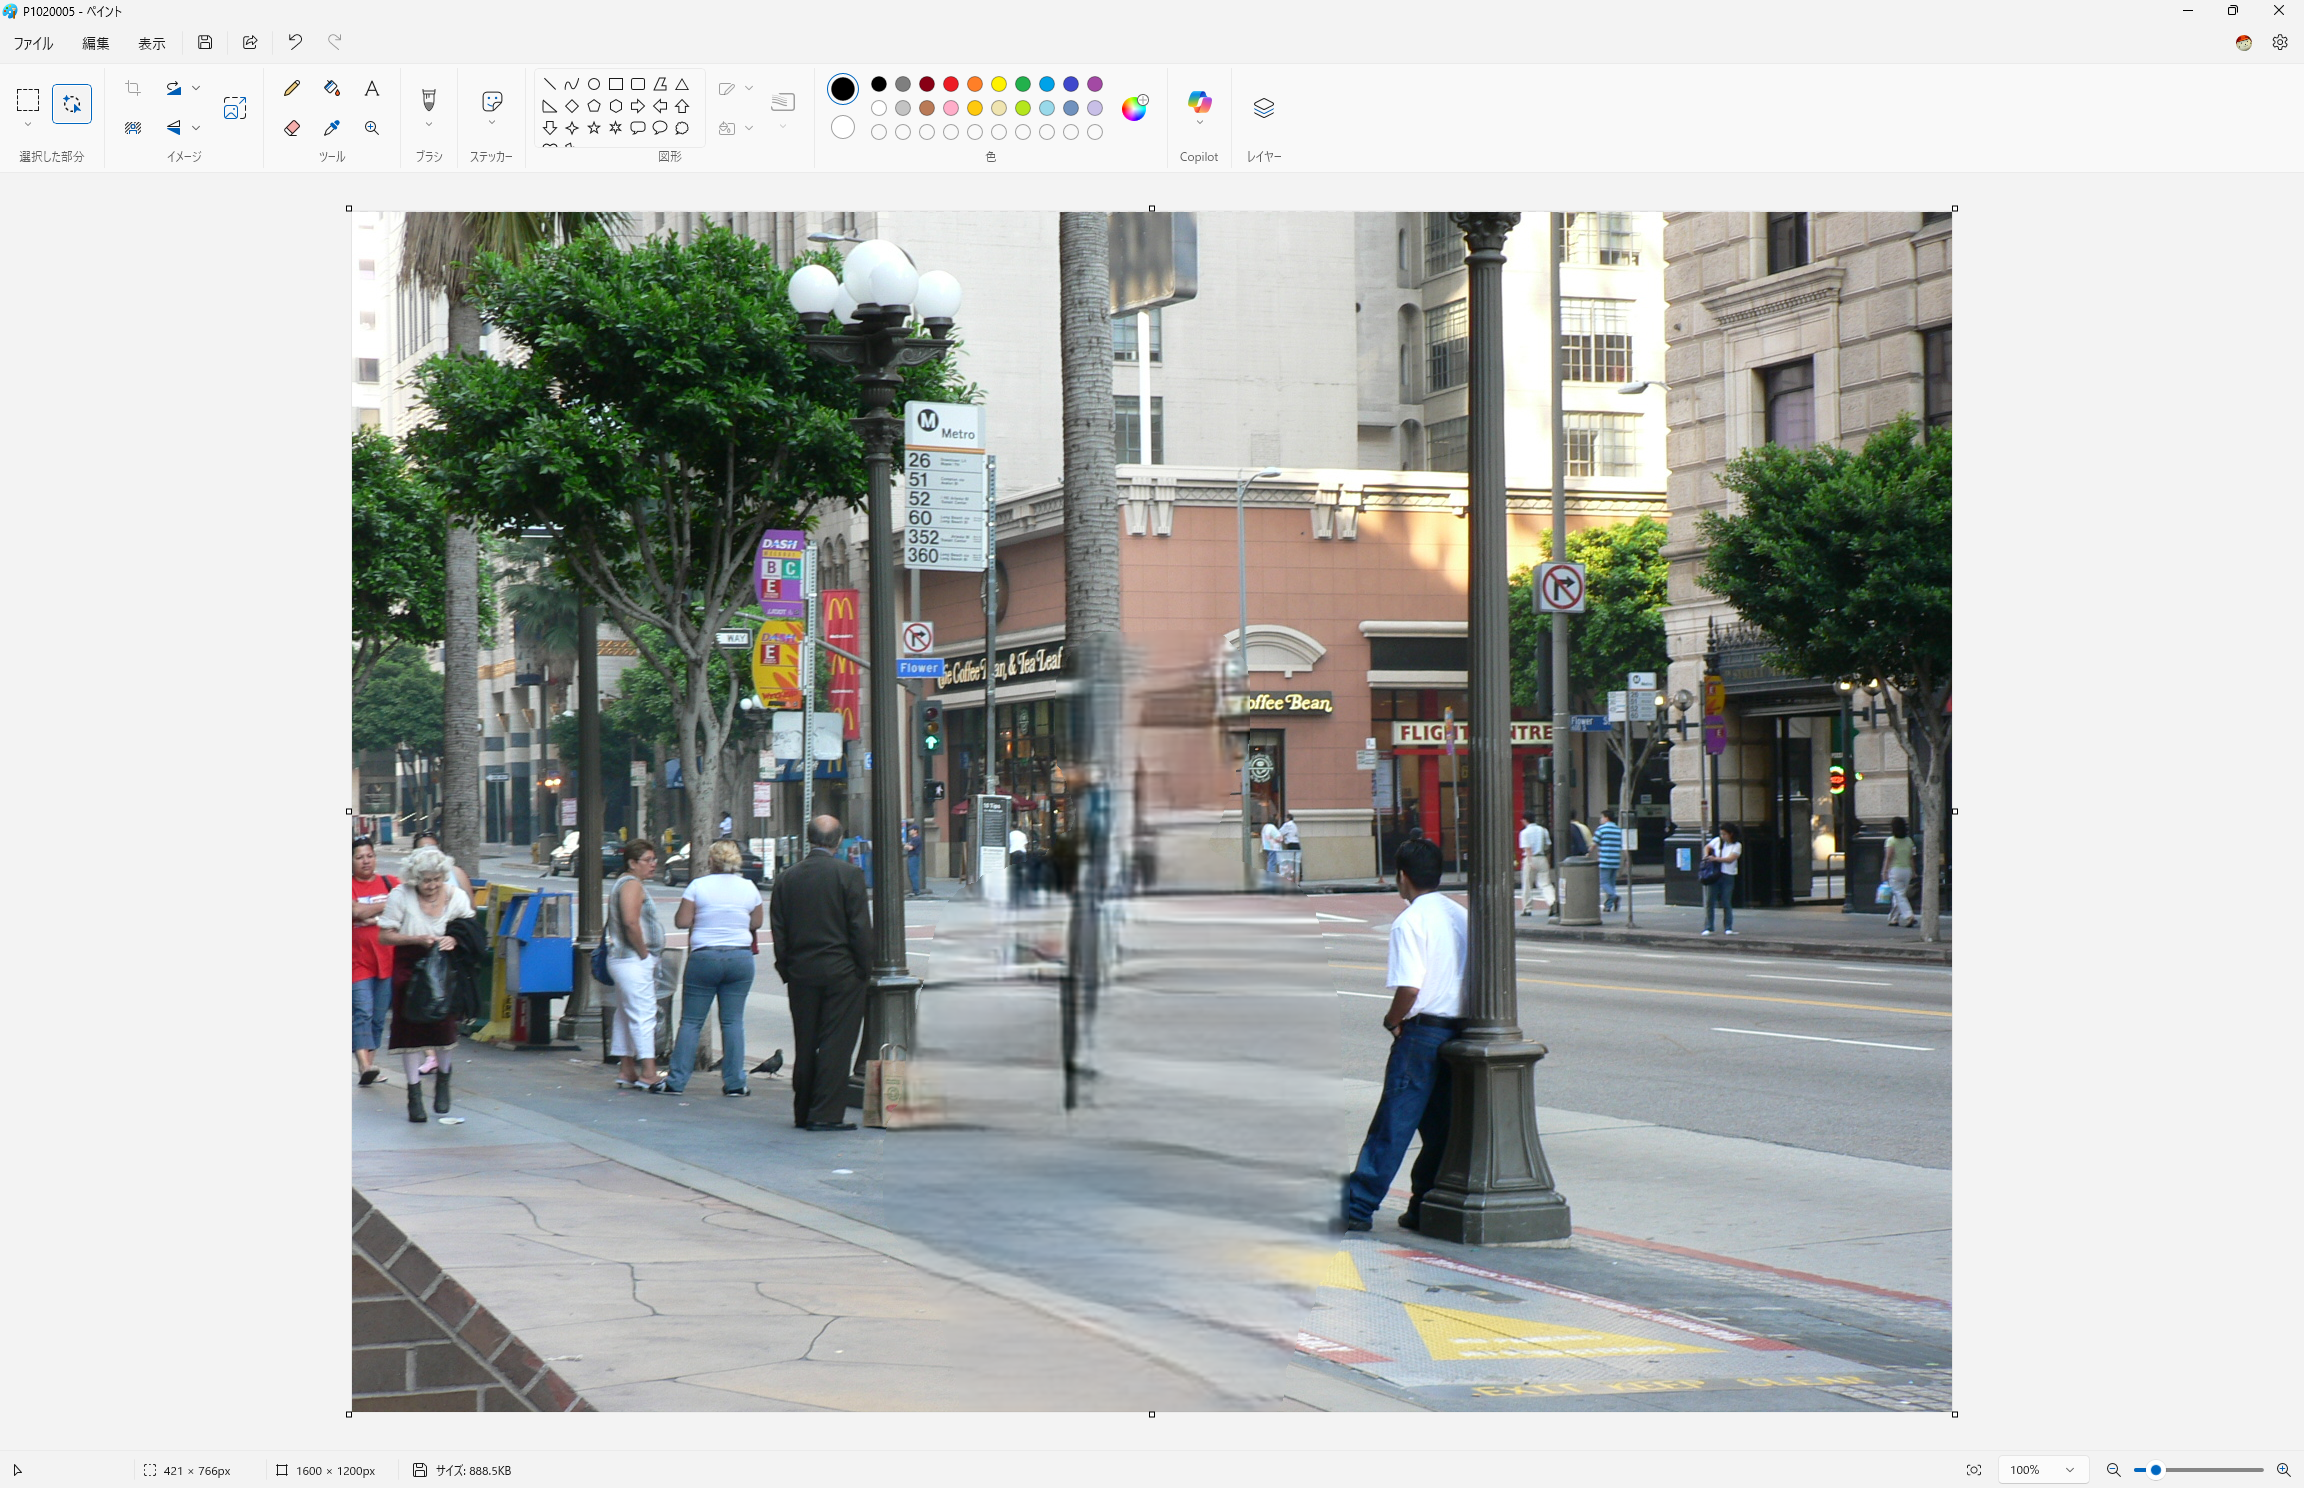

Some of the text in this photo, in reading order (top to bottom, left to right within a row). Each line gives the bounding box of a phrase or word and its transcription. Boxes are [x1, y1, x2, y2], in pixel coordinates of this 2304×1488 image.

[23, 6, 76, 17] P1020005
[86, 5, 122, 18] ペイント
[13, 36, 54, 51] ファイル
[81, 36, 110, 51] 編集
[137, 36, 166, 51] 表示
[18, 150, 85, 163] 選択した部分
[167, 150, 202, 163] イメージ
[319, 150, 346, 163] ツール
[415, 149, 443, 163] ブラシ
[469, 150, 513, 163] ステッカー
[658, 150, 683, 163] 図形
[984, 150, 997, 163] 色
[1179, 151, 1219, 165] Copilot
[1247, 150, 1282, 163] レイヤー
[920, 413, 937, 429] M
[941, 427, 976, 440] Metro
[909, 452, 931, 468] 26
[909, 472, 927, 487] 51
[909, 491, 930, 506] 52
[909, 510, 932, 525] 60
[762, 539, 798, 549] DASH
[908, 529, 939, 545] 352
[908, 547, 939, 563] 360
[767, 561, 776, 574] B
[785, 561, 796, 575] C
[766, 580, 776, 593] E
[727, 634, 746, 642] WAY
[765, 645, 776, 659] E
[900, 662, 938, 673] Flower
[953, 660, 981, 685] Coffee
[1008, 653, 1017, 677] &
[1017, 649, 1036, 676] Tea
[1037, 646, 1064, 673] Leaf
[1285, 693, 1333, 713] Bean
[1571, 716, 1594, 725] Flower
[1401, 725, 1469, 741] FLIGT
[1472, 1376, 1875, 1397] EXIT KEEP CLEAR
[163, 1466, 183, 1476] 421
[197, 1466, 231, 1479] 766px
[296, 1466, 323, 1476] 1600
[337, 1466, 376, 1479] 1200px
[435, 1463, 512, 1477] サイズ: 888.5KB
[2010, 1464, 2040, 1475] 100%
